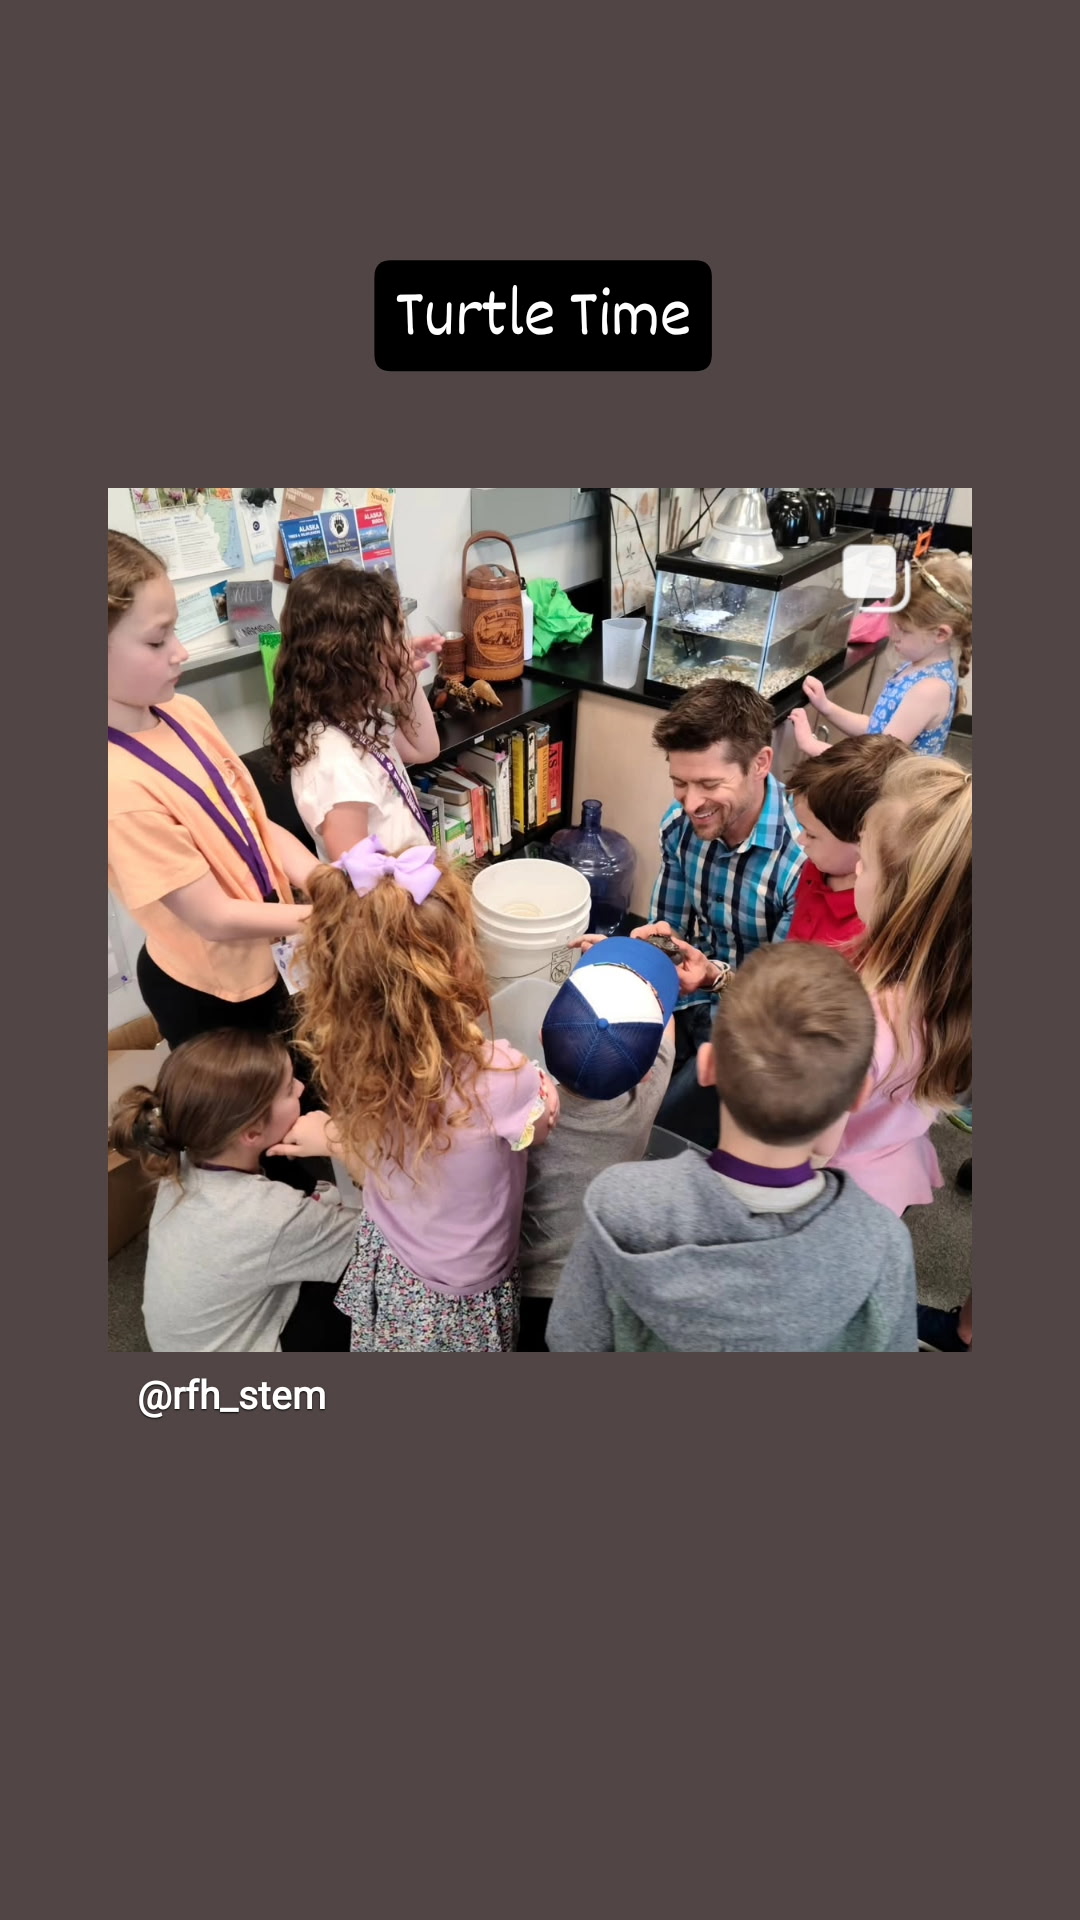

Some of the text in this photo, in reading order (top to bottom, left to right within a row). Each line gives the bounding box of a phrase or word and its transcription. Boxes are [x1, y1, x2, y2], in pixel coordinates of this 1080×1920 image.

[364, 512, 383, 520] ALASKA
[299, 524, 320, 533] ALASKA
[233, 586, 262, 603] WILD
